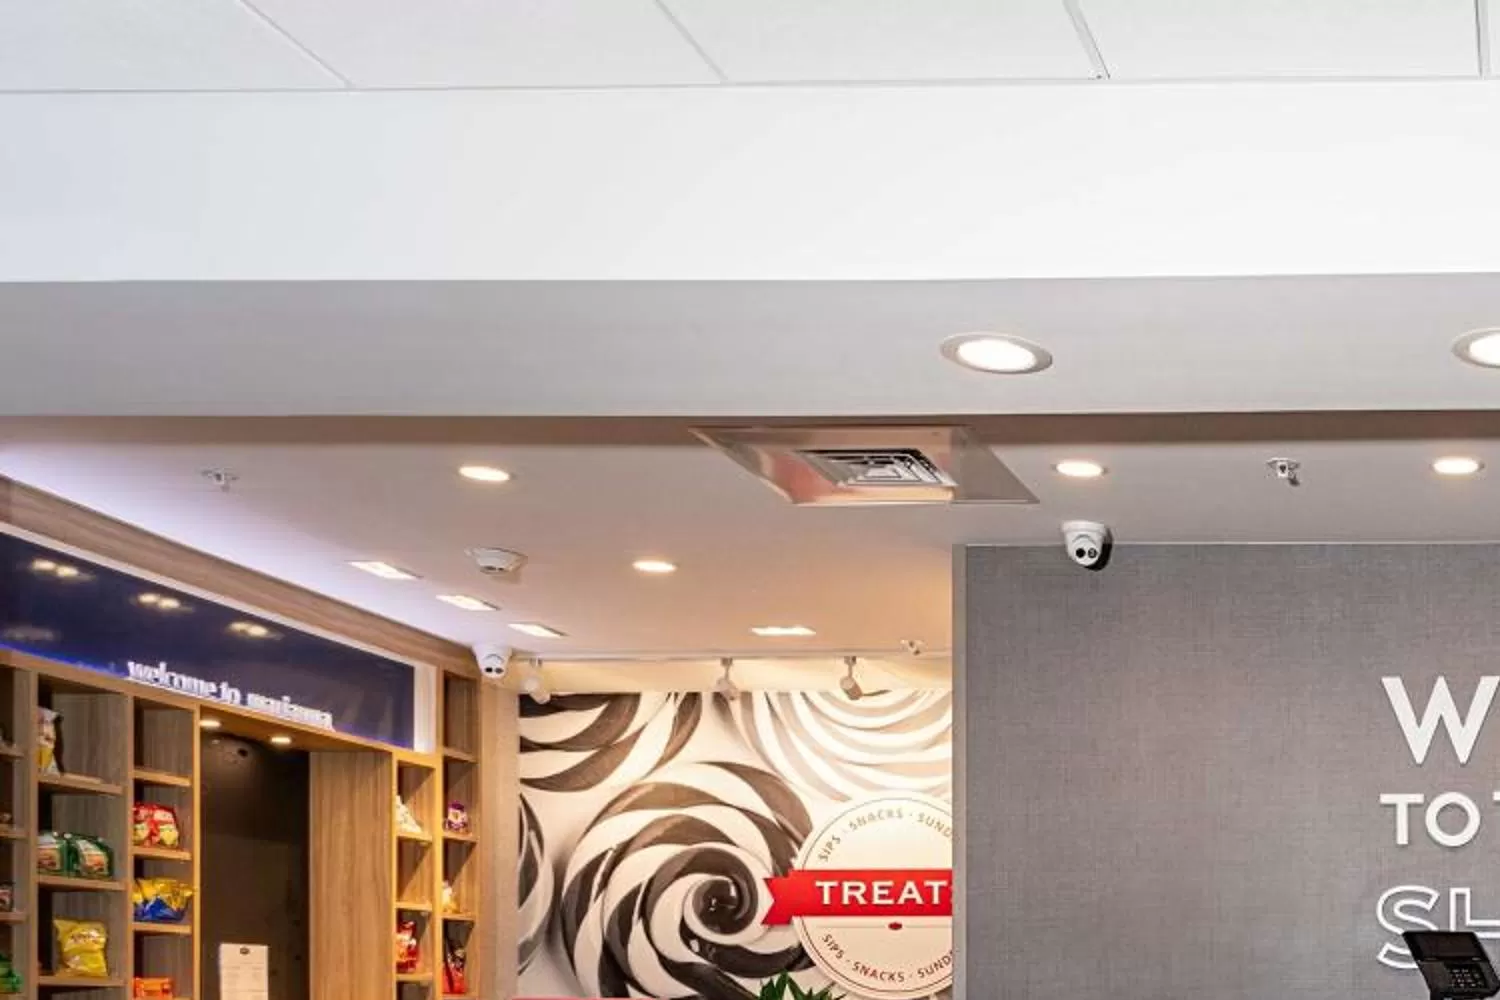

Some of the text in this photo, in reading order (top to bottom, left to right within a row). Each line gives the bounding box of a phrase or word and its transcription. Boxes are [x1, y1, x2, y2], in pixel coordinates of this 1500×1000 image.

[818, 808, 953, 862] SIPS SNACKS SUND
[1380, 791, 1480, 847] TO
[815, 880, 952, 905] TREAT
[822, 932, 953, 982] SIPS SNACKS SUND
